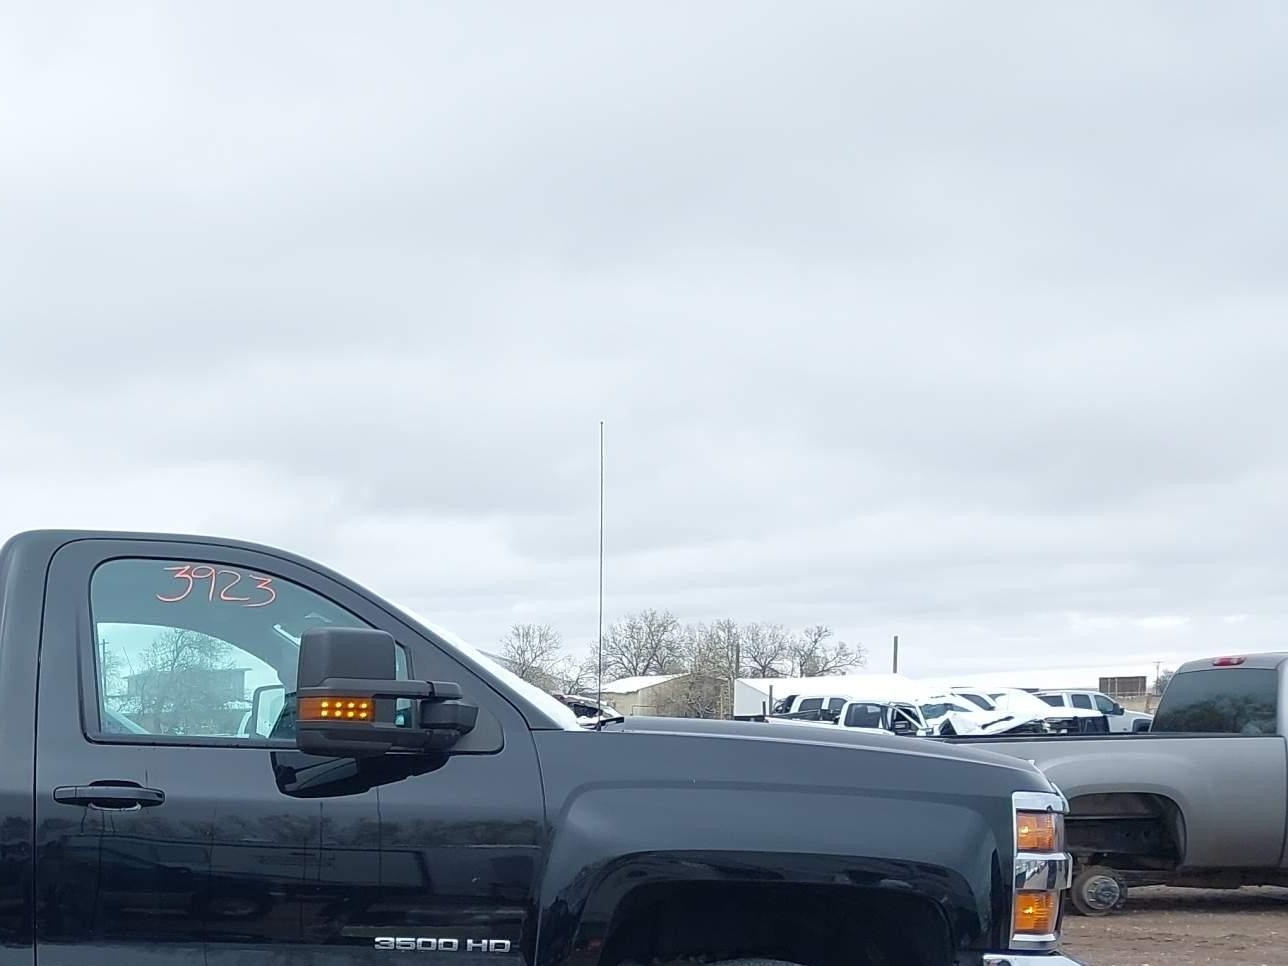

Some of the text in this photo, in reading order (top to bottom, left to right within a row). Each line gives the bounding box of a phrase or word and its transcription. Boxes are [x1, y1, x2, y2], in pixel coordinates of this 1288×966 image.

[156, 565, 276, 608] 3923
[374, 936, 511, 953] 3500 HD
